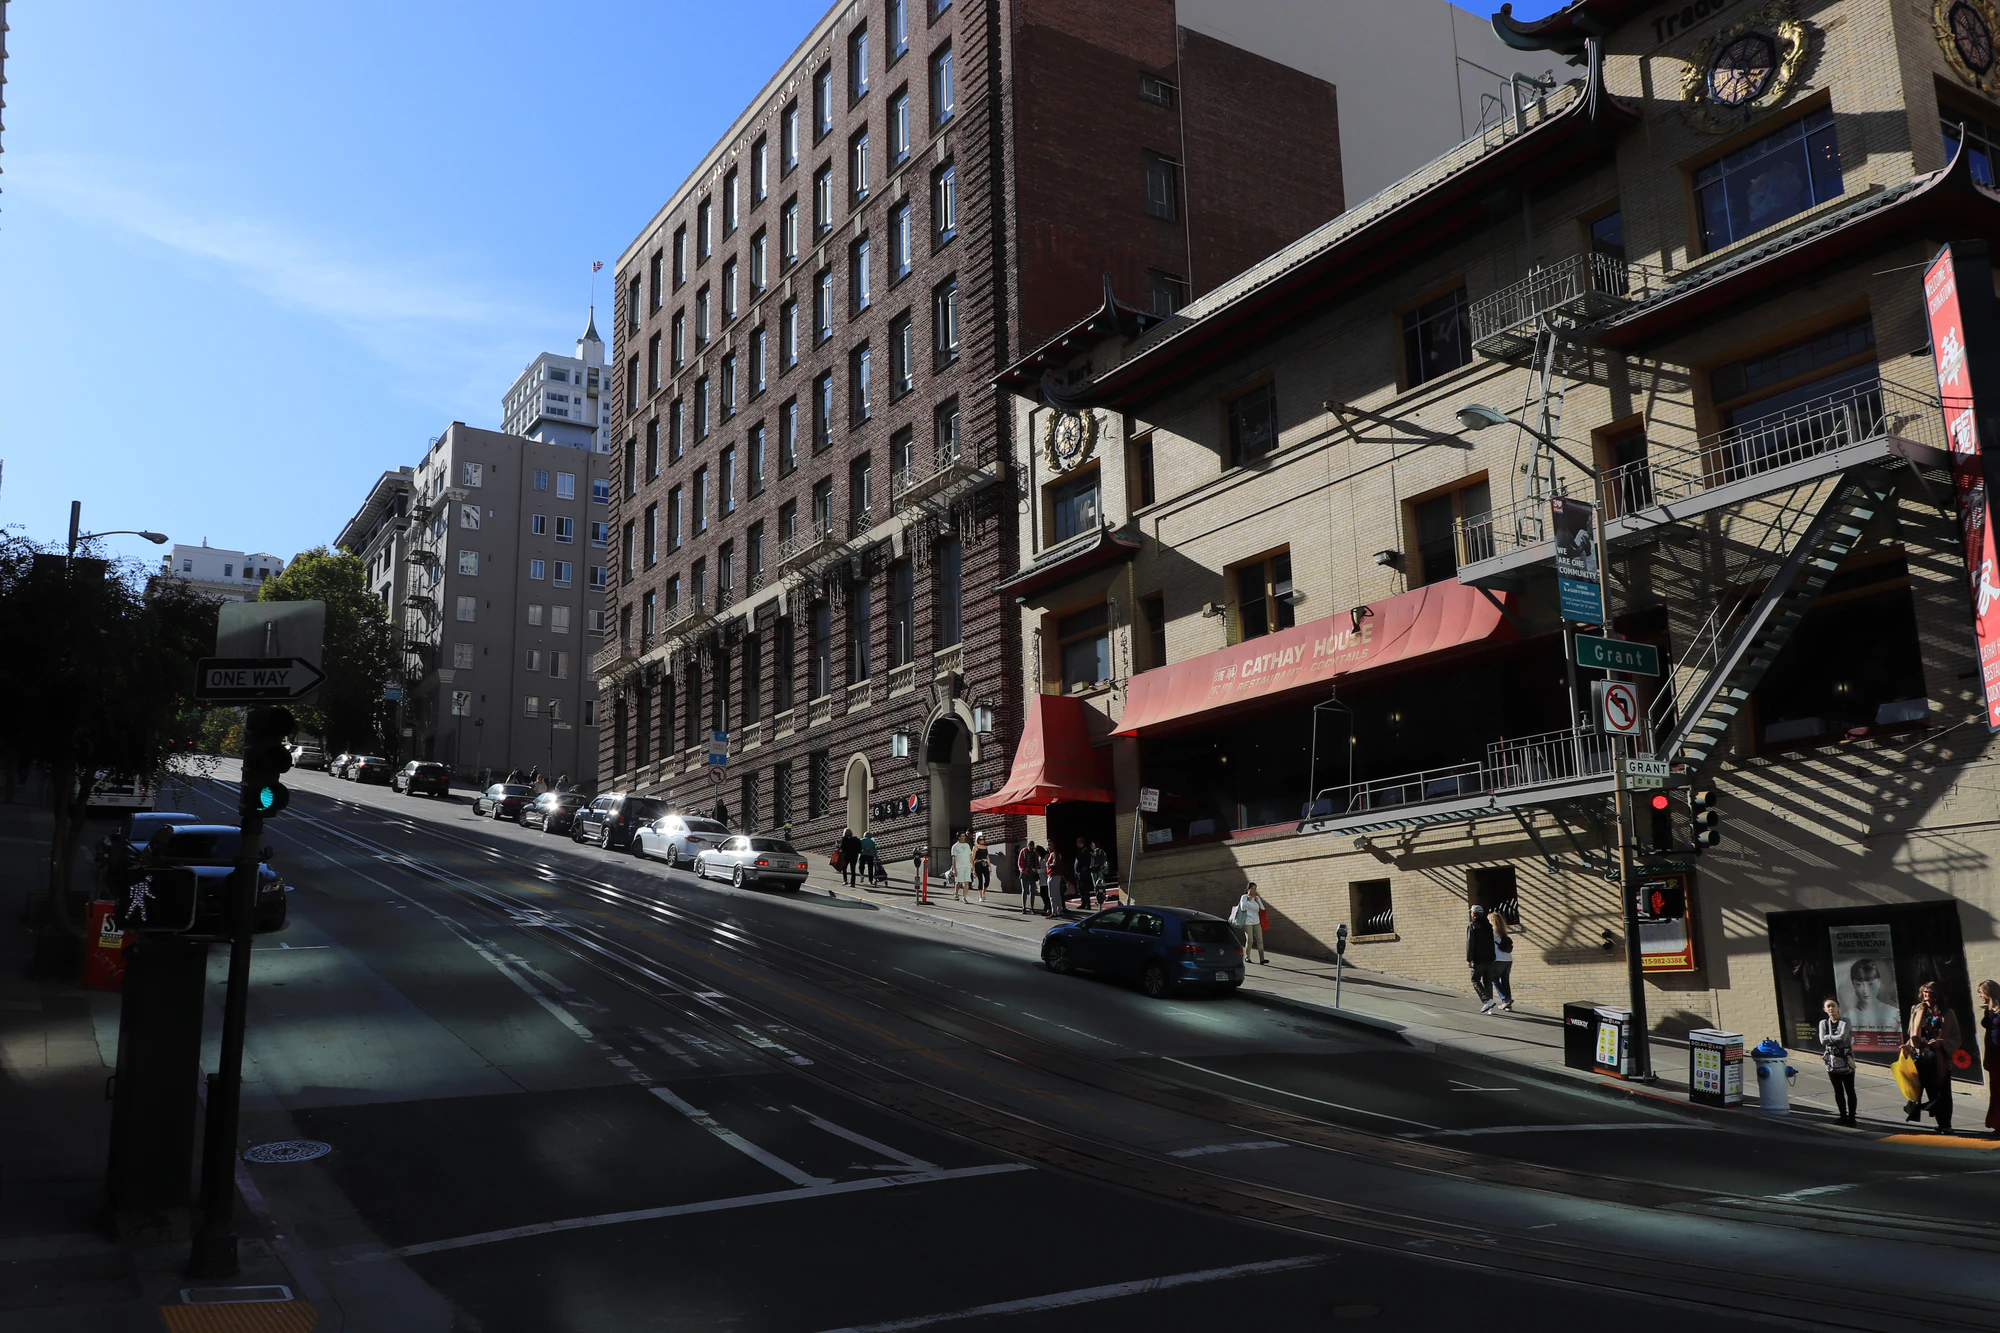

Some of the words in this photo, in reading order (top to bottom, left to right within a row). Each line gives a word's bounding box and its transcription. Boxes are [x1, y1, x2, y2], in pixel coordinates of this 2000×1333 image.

[1556, 547, 1568, 555] WE
[1558, 557, 1571, 566] ARE
[1571, 559, 1585, 568] ONE
[1559, 566, 1597, 580] COMMUNITY
[1241, 643, 1307, 678] CATHAY
[1312, 622, 1374, 659] HOUSE
[1594, 644, 1642, 667] Grant
[1236, 666, 1302, 692] RESTAURANT
[1310, 648, 1369, 673] COCKTAILS
[211, 670, 247, 686] ONE
[253, 670, 289, 686] WAY
[1630, 761, 1667, 775] GRANT
[1836, 931, 1877, 940] CHINESE
[1837, 940, 1886, 948] AMERICAN
[1571, 1018, 1588, 1029] WEEKLY
